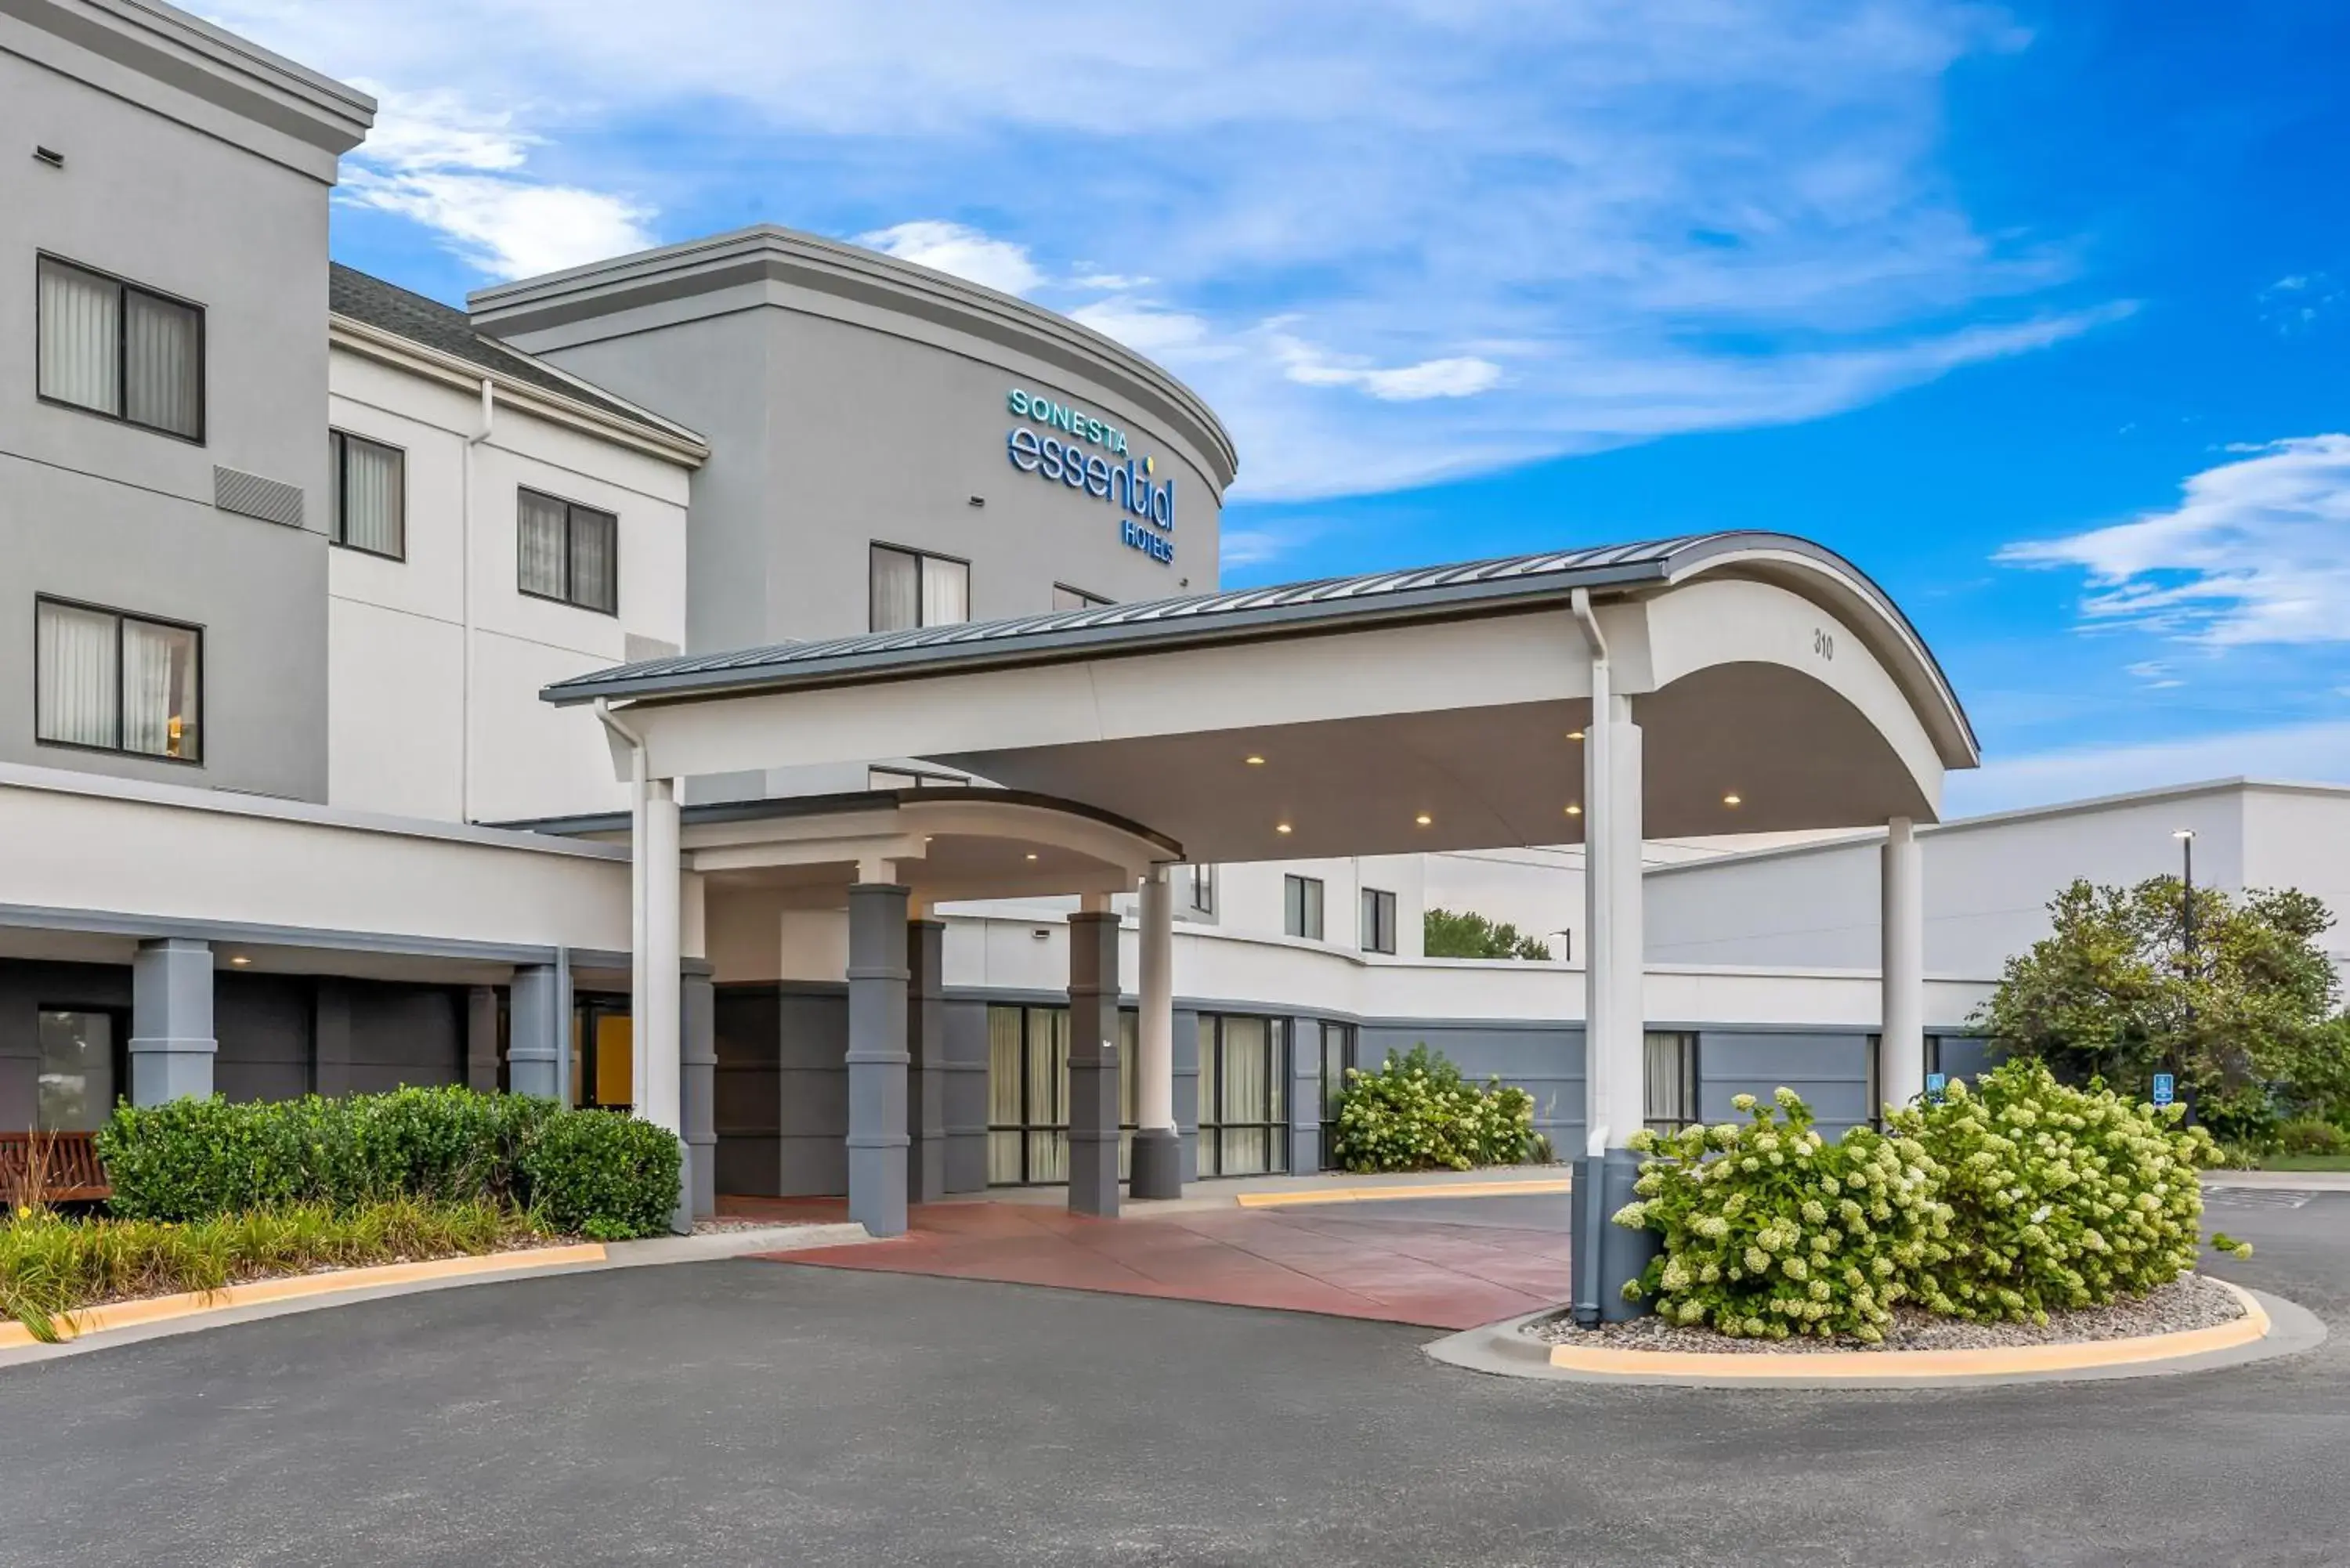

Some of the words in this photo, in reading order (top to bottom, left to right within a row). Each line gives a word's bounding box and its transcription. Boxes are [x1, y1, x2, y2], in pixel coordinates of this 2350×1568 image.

[1008, 388, 1129, 456] SONESTA
[1008, 427, 1175, 532] essential
[1122, 519, 1174, 565] HOTELS
[1814, 627, 1833, 662] 310
